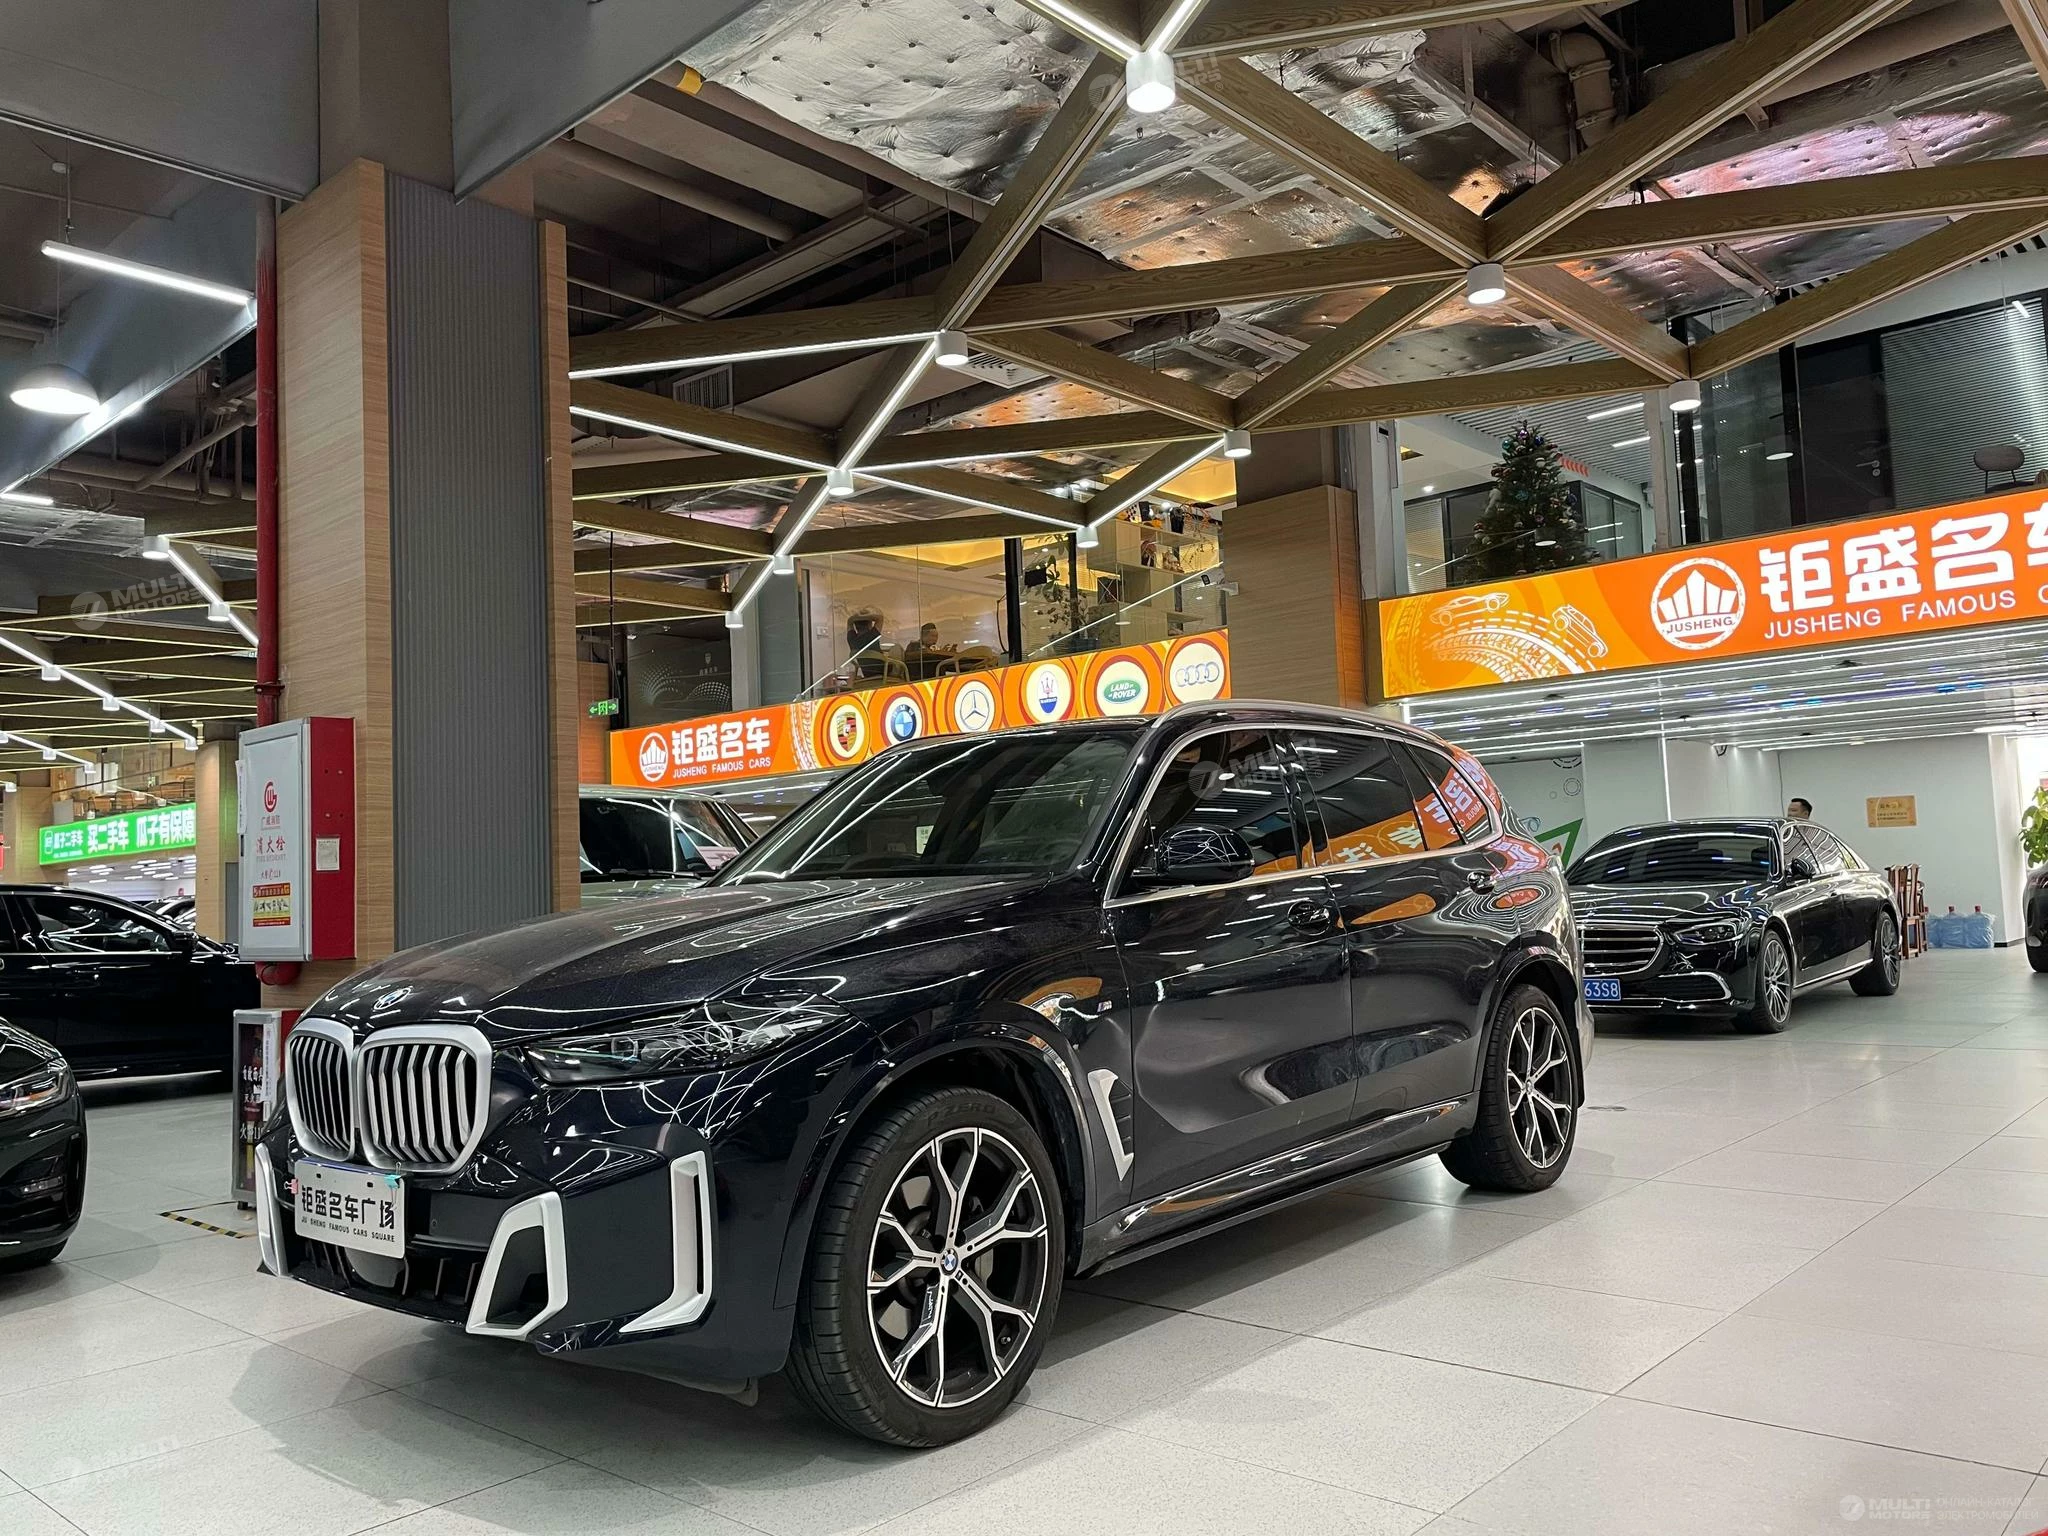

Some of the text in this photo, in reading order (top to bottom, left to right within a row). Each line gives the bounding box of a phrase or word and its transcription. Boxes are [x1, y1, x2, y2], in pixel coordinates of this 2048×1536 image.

[1666, 616, 1733, 634] JUSHENG
[1764, 608, 1881, 639] JUSHENG
[1902, 590, 2016, 622] FAMOUS
[1111, 682, 1130, 691] LAND
[1112, 688, 1136, 698] ROVER
[671, 717, 770, 766] 钜盛名车
[673, 757, 771, 779] JUSHENG FAMOUS CARS
[53, 830, 84, 850] 瓜子二手车
[88, 807, 196, 853] 买二手车 瓜子有保障
[1585, 982, 1619, 997] 63S8
[301, 1184, 395, 1229] 钜盛名车广场
[310, 1218, 326, 1228] SHENG
[329, 1222, 350, 1234] FAMOUS
[353, 1228, 368, 1238] CARS
[371, 1231, 395, 1243] SQUARE
